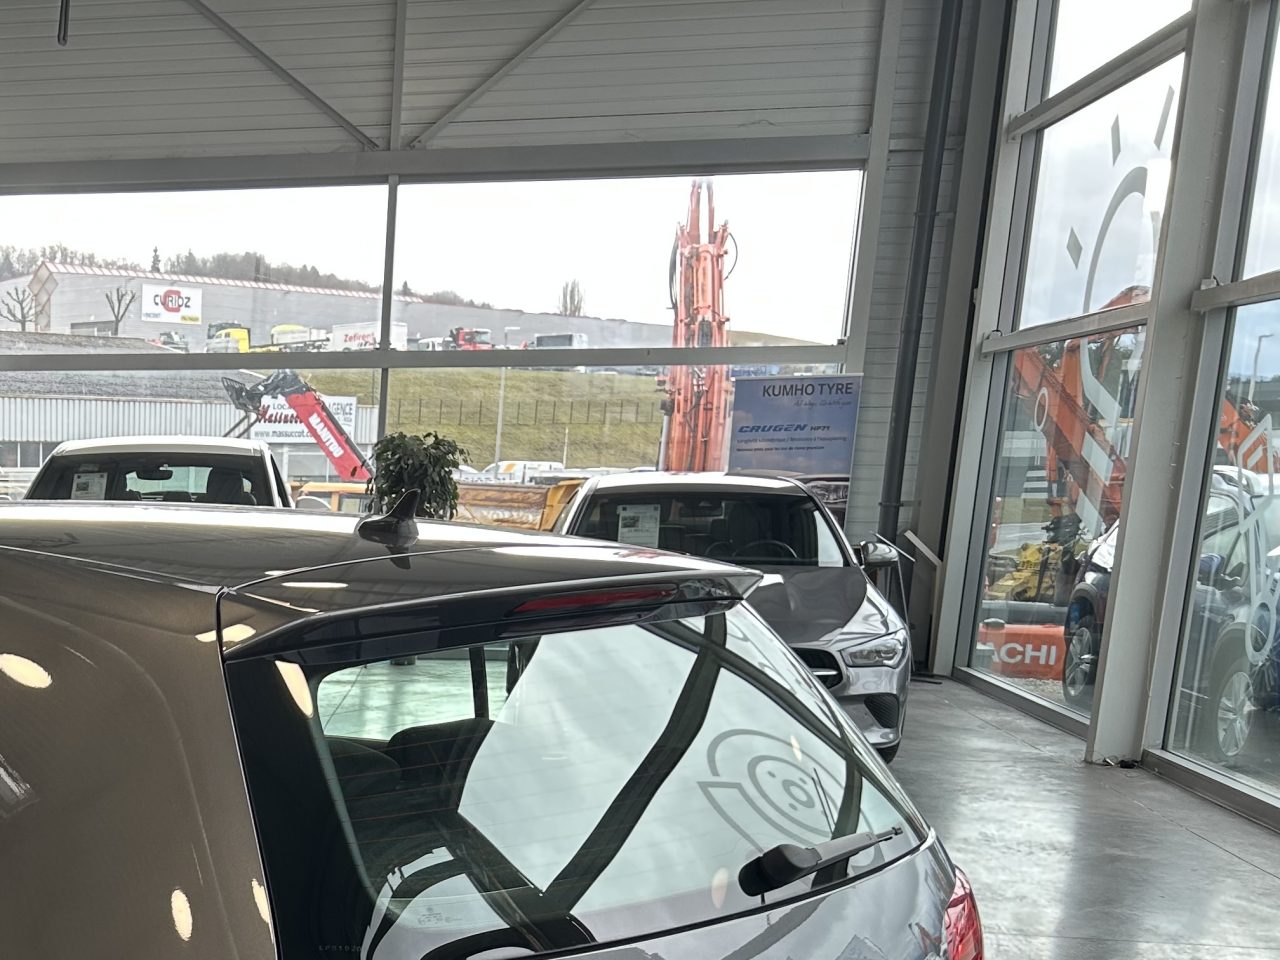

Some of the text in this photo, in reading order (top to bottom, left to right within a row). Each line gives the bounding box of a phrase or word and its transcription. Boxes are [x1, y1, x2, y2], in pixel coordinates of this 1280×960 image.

[153, 293, 191, 309] CURIOZ
[762, 382, 854, 397] KUMHO TYRE
[308, 412, 344, 458] MANITOU
[738, 423, 808, 433] CRUGEN
